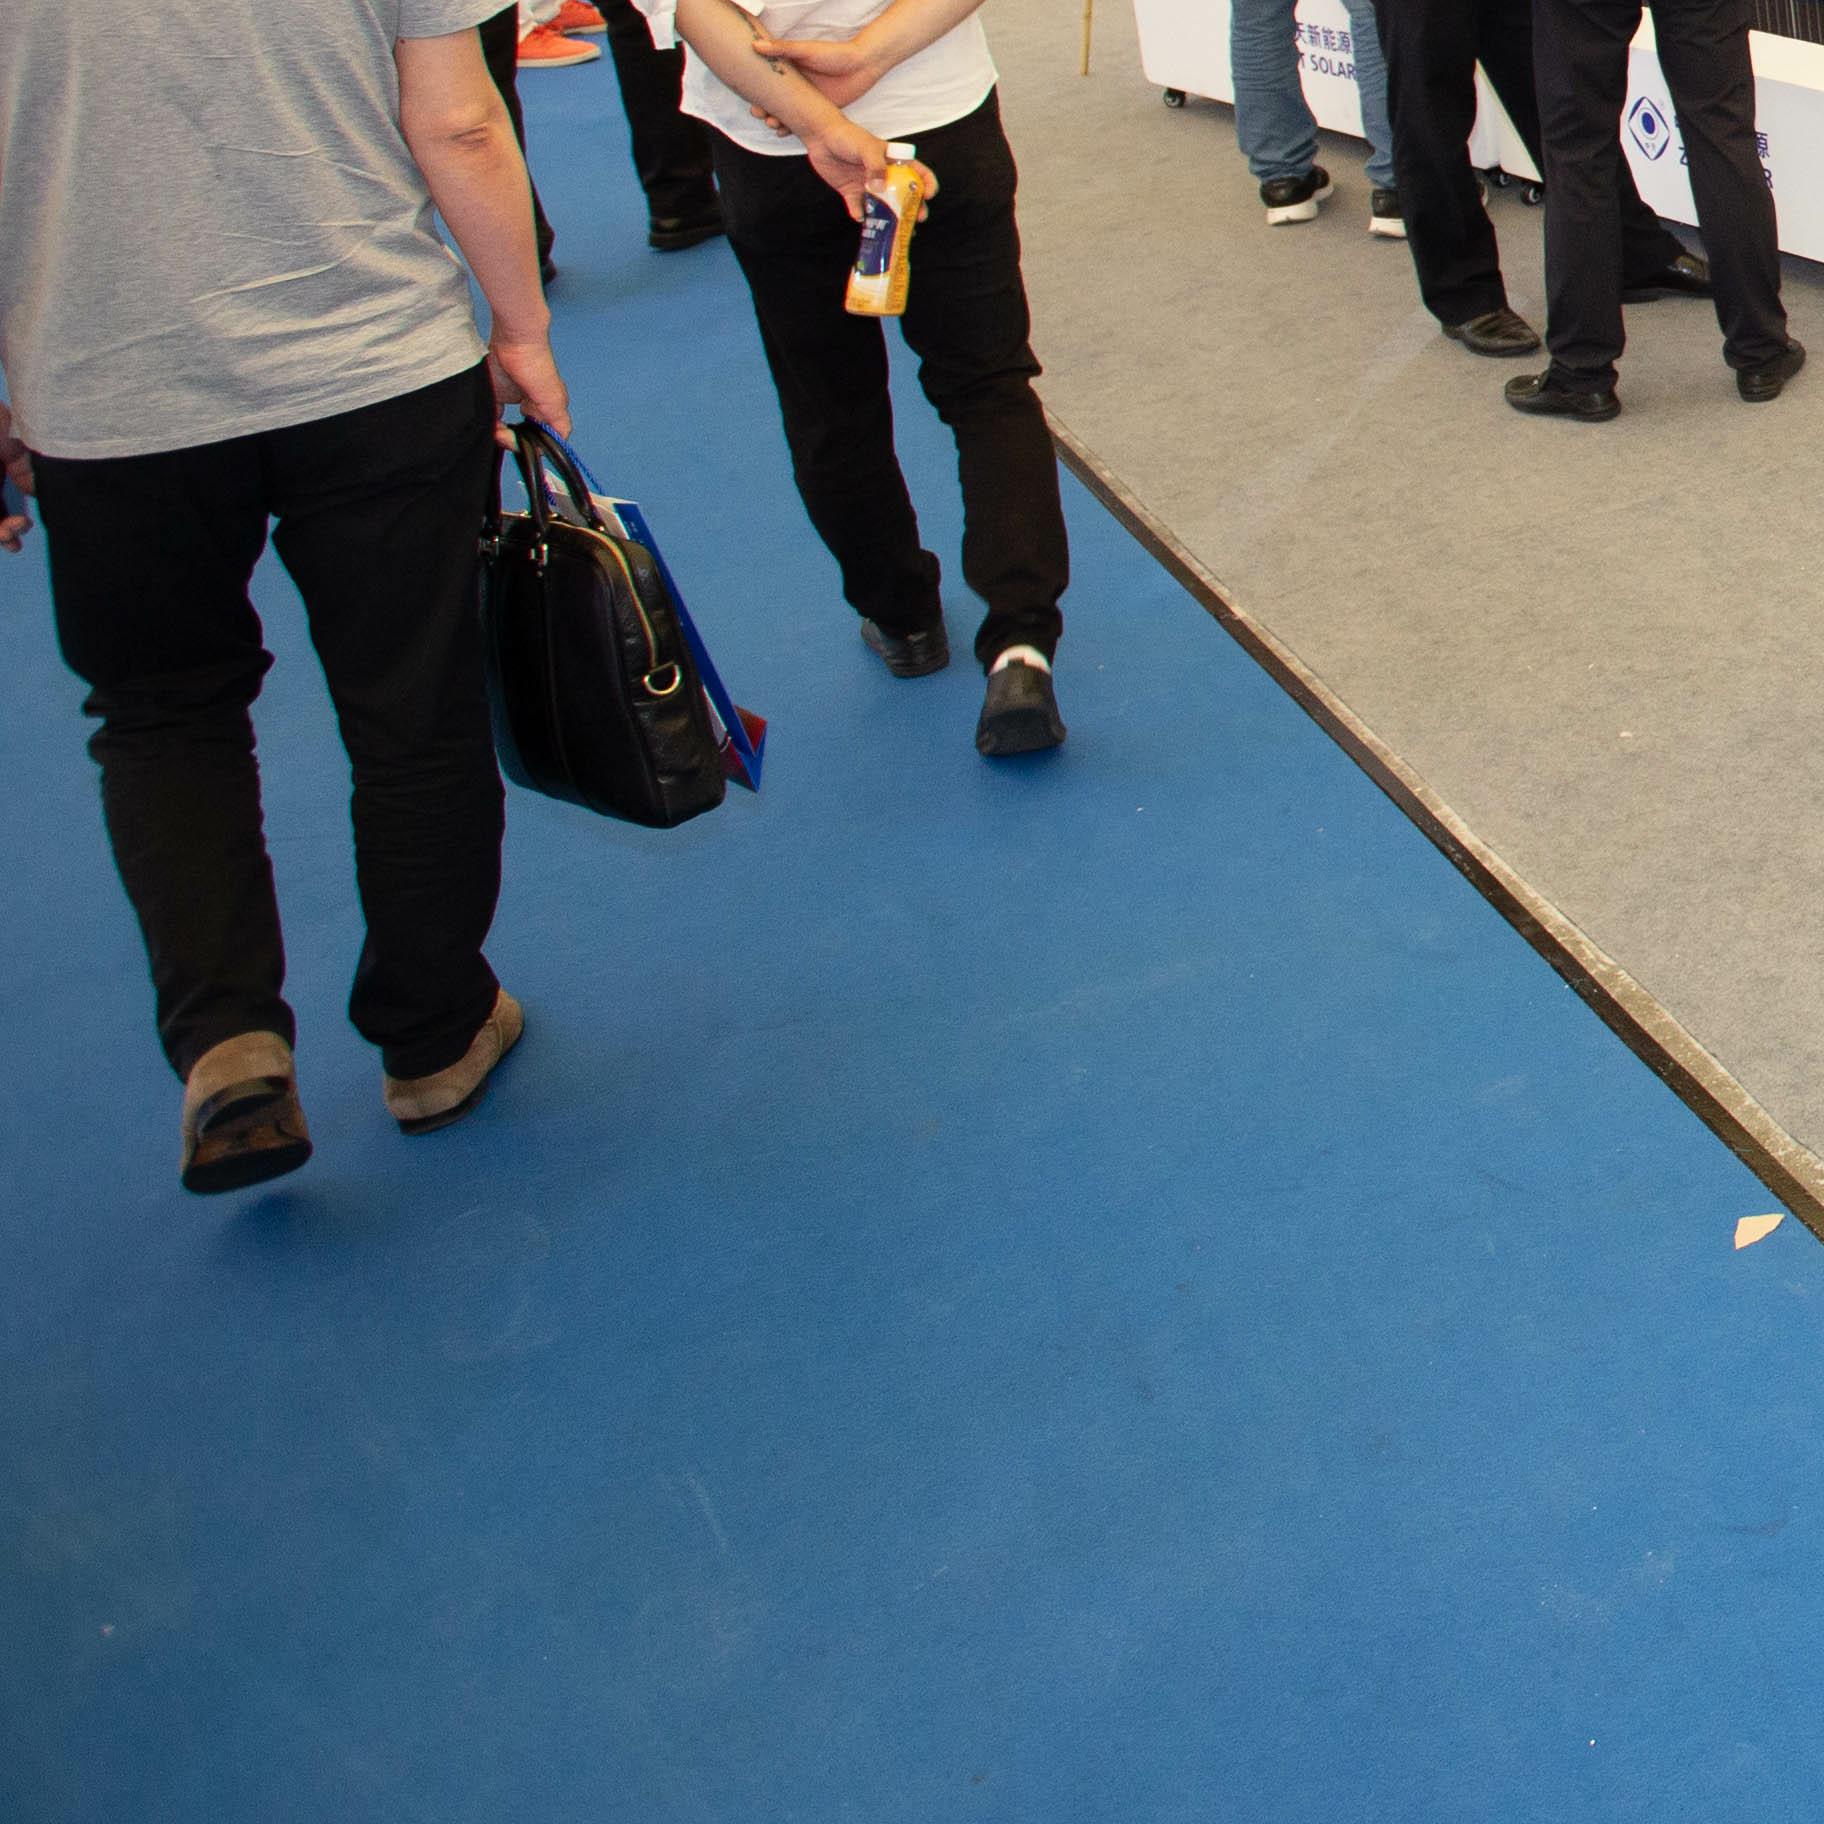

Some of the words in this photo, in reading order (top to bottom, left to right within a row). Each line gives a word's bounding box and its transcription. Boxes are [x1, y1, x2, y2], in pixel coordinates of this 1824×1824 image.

[1295, 22, 1352, 56] 天新能源
[1310, 55, 1356, 80] SOLAR
